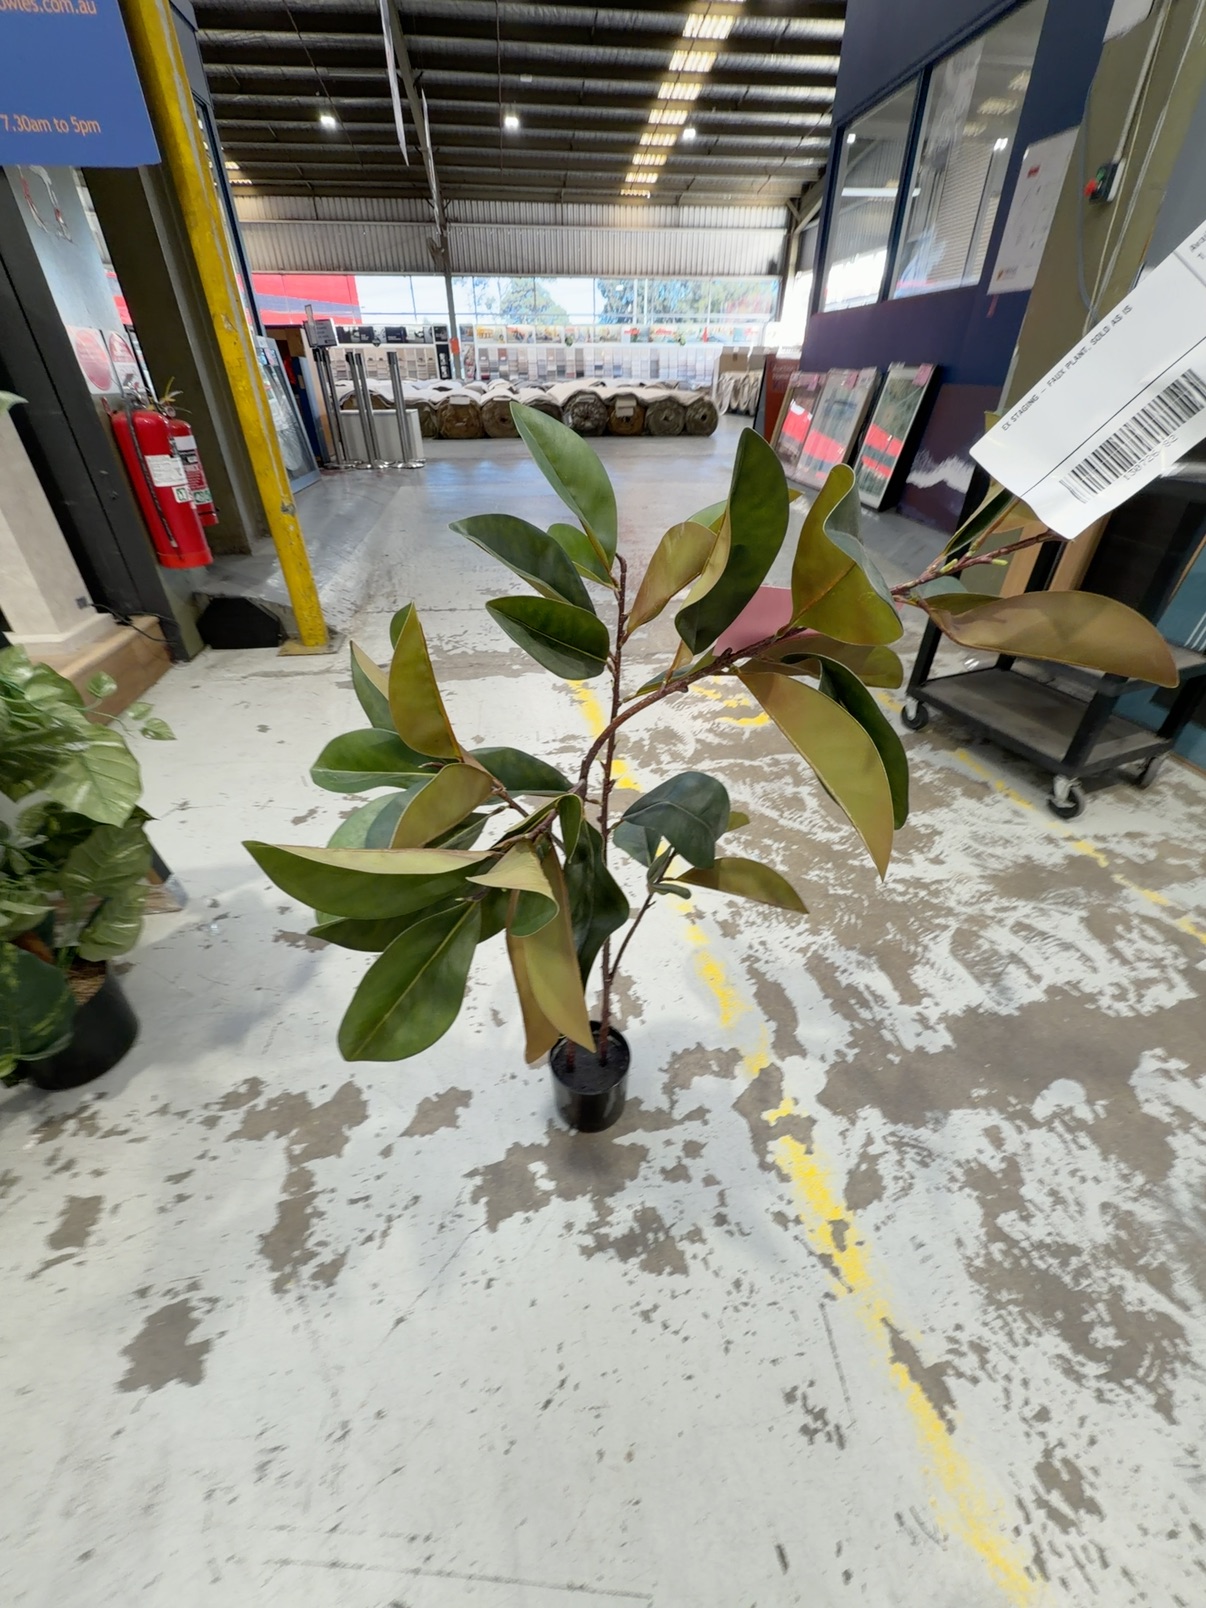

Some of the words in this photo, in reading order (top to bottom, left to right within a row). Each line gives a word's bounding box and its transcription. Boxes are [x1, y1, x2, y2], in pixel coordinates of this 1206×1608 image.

[0, 114, 52, 132] 7.30am
[53, 117, 70, 133] to
[70, 115, 101, 136] 5pm
[1002, 421, 1012, 431] EX
[1010, 394, 1040, 422] STAGING
[1046, 368, 1065, 387] FAUX
[1090, 325, 1110, 345] SOLD
[1111, 313, 1123, 326] AS
[1122, 304, 1133, 315] IS
